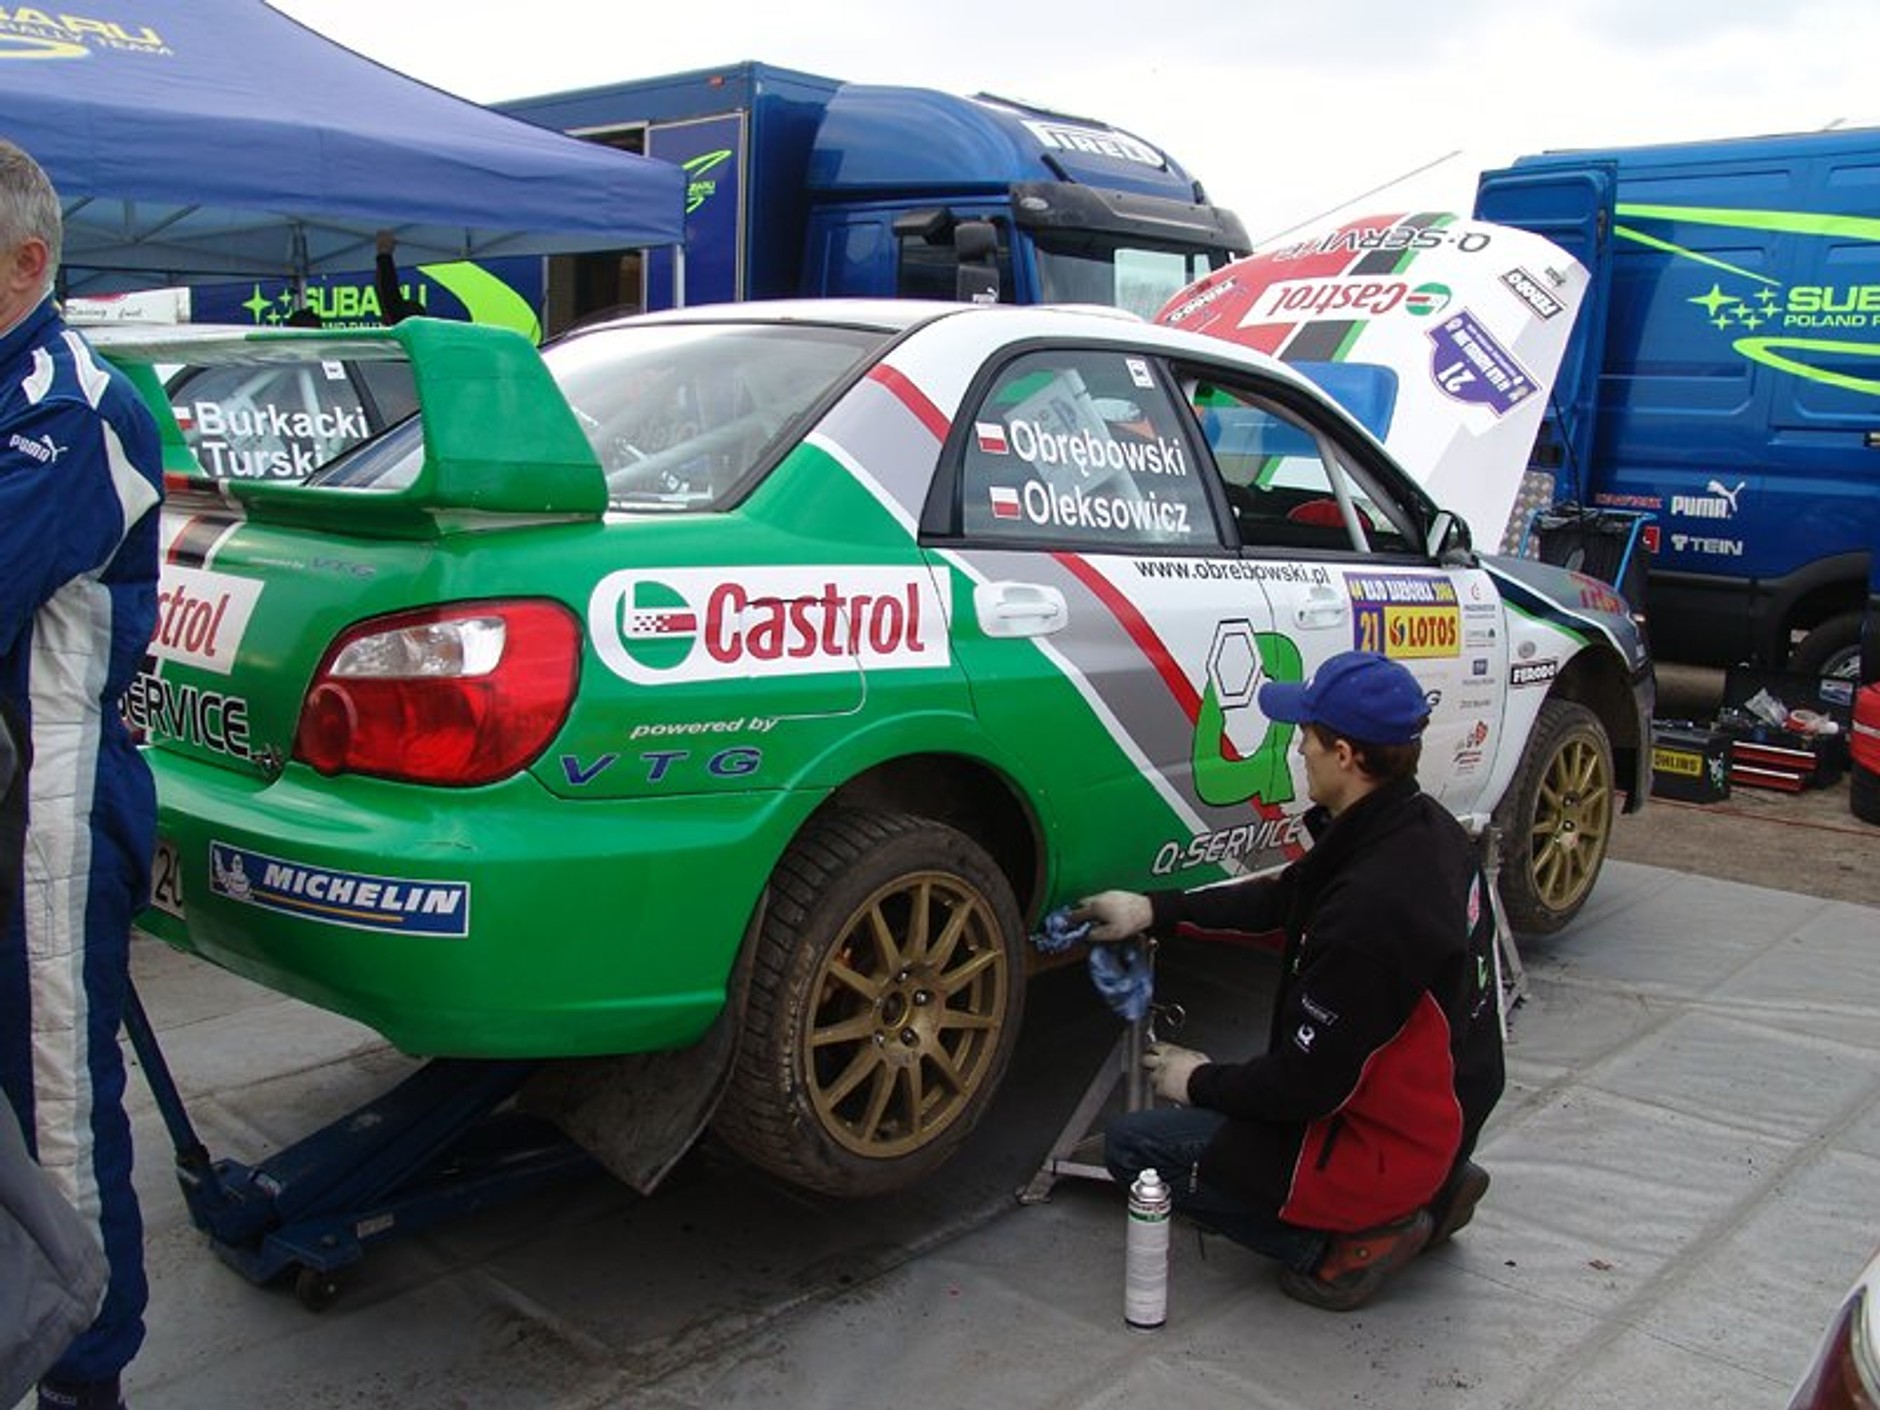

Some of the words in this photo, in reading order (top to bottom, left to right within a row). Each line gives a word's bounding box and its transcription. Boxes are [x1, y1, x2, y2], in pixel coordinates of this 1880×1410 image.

[305, 284, 427, 318] SUBAU
[1267, 283, 1408, 316] Castrol
[1783, 314, 1866, 327] POLAND
[194, 401, 369, 438] Burkacki
[201, 441, 326, 477] Turski
[1009, 418, 1187, 478] Obrębowski
[1023, 479, 1191, 534] Oleksowicz
[1689, 536, 1744, 556] TEIN
[705, 582, 925, 664] Castrol
[1359, 610, 1379, 654] 21
[1408, 615, 1456, 648] LOTOS
[629, 718, 744, 740] powered
[747, 716, 781, 733] by
[263, 863, 462, 914] MICHELIN
